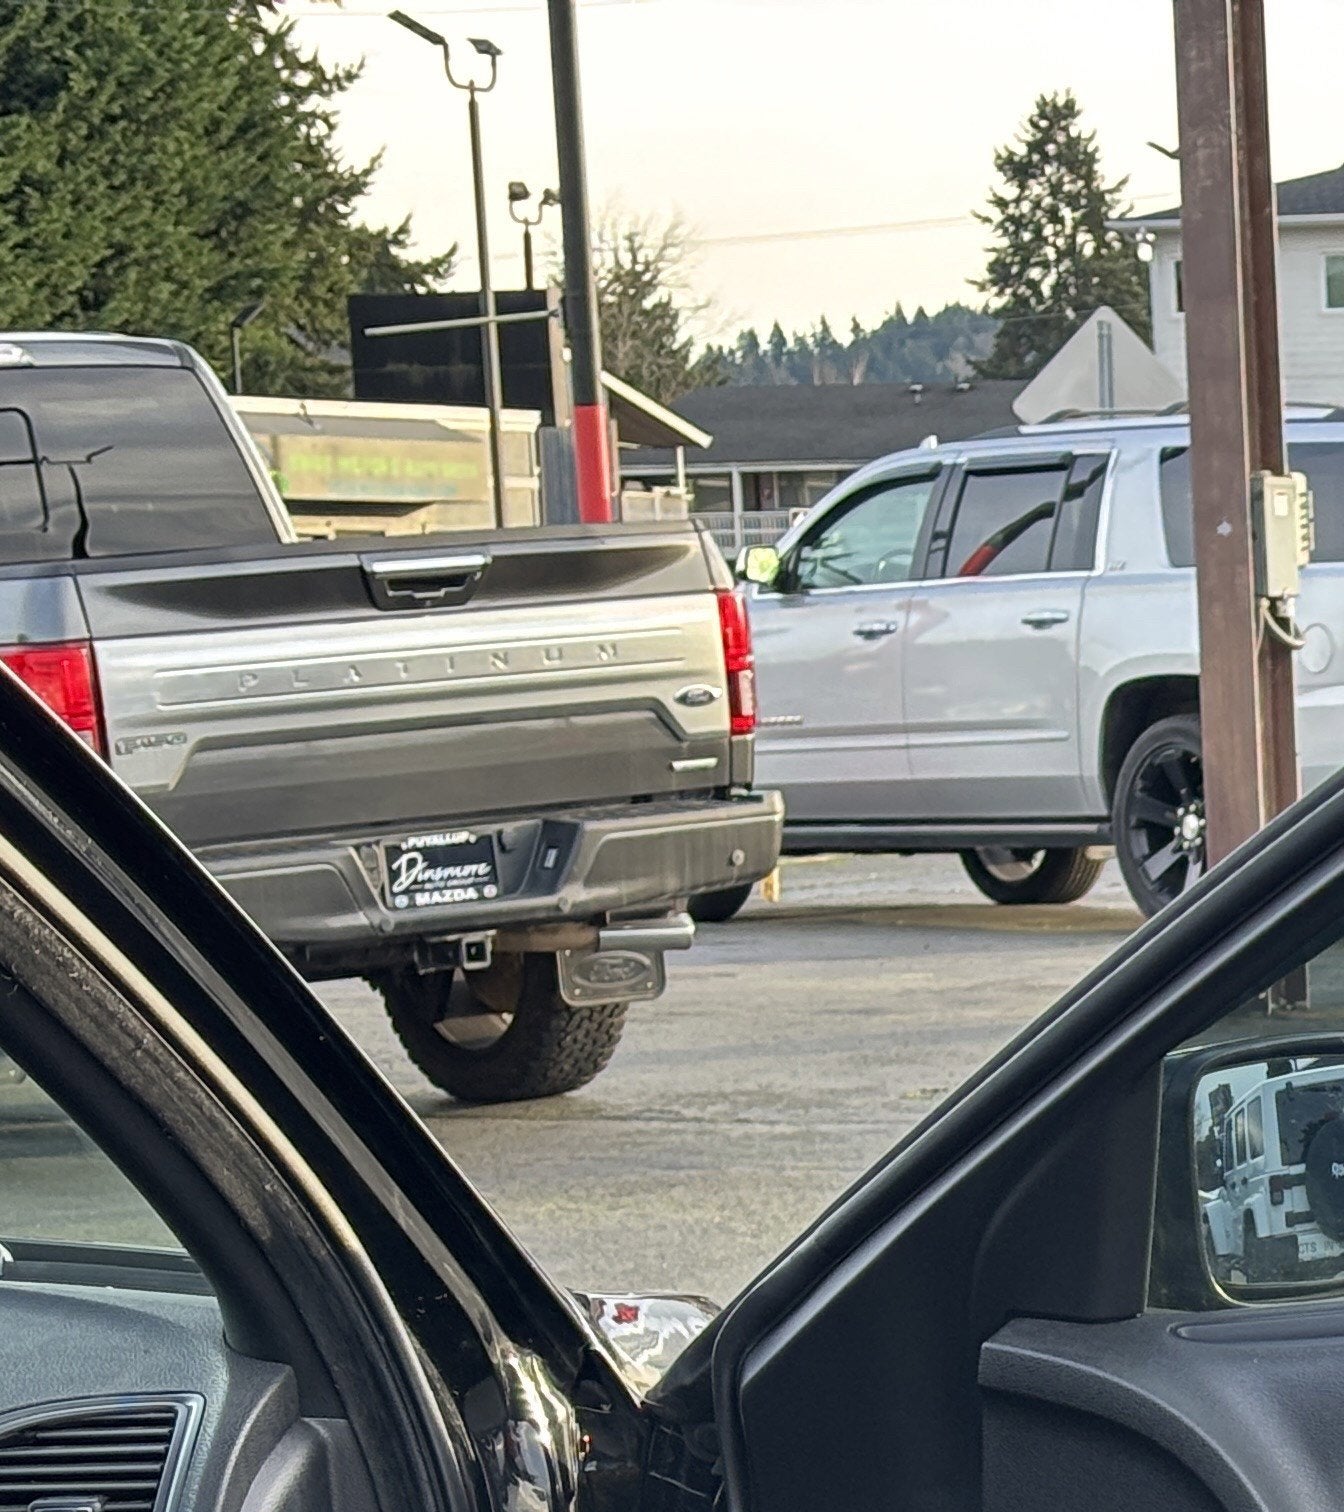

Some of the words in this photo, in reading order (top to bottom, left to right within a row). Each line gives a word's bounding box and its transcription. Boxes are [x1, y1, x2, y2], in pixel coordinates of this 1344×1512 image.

[237, 642, 618, 693] PLATINUM
[391, 851, 493, 893] Dinsmore
[415, 887, 479, 907] MAZDA
